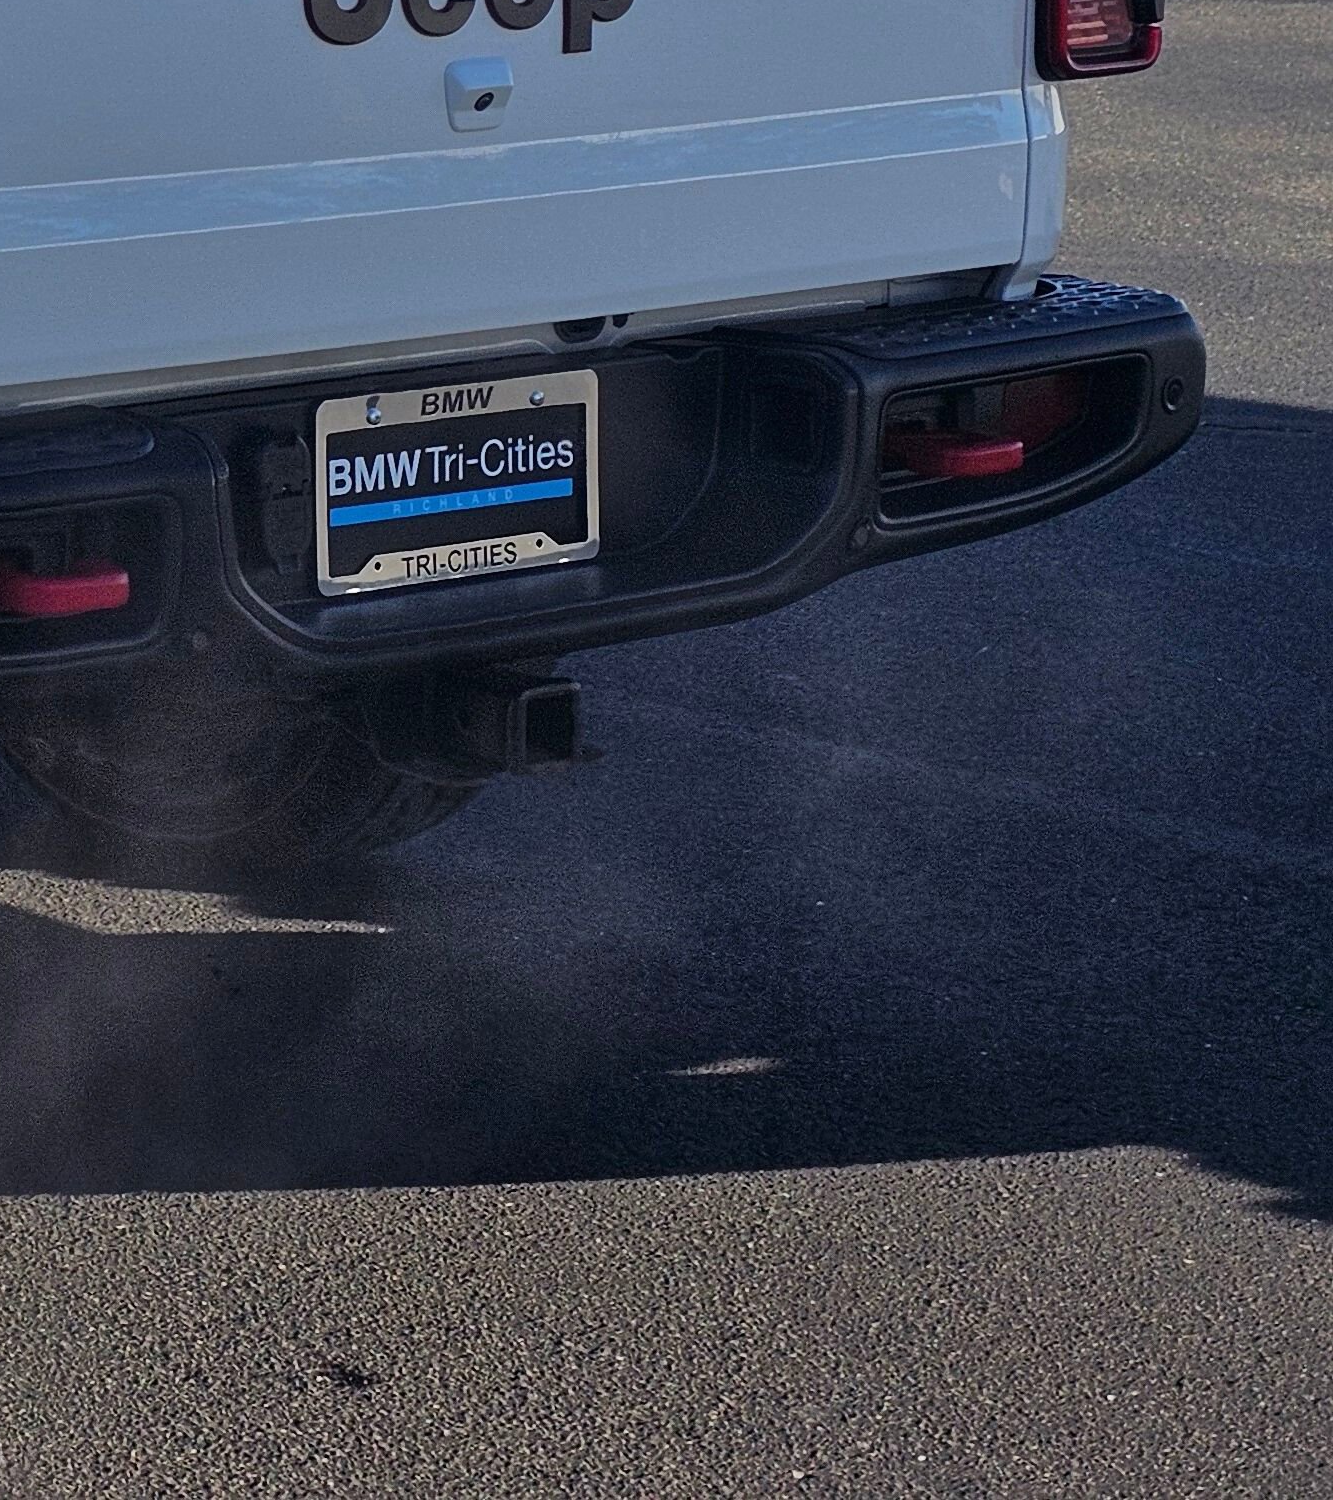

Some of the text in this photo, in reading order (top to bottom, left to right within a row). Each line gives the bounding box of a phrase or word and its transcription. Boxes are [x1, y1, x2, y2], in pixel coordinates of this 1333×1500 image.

[420, 385, 495, 417] BMW
[328, 435, 574, 497] BMW Tri-Cities
[392, 488, 515, 516] RICHLAND
[402, 541, 518, 579] TRI-CITIES
